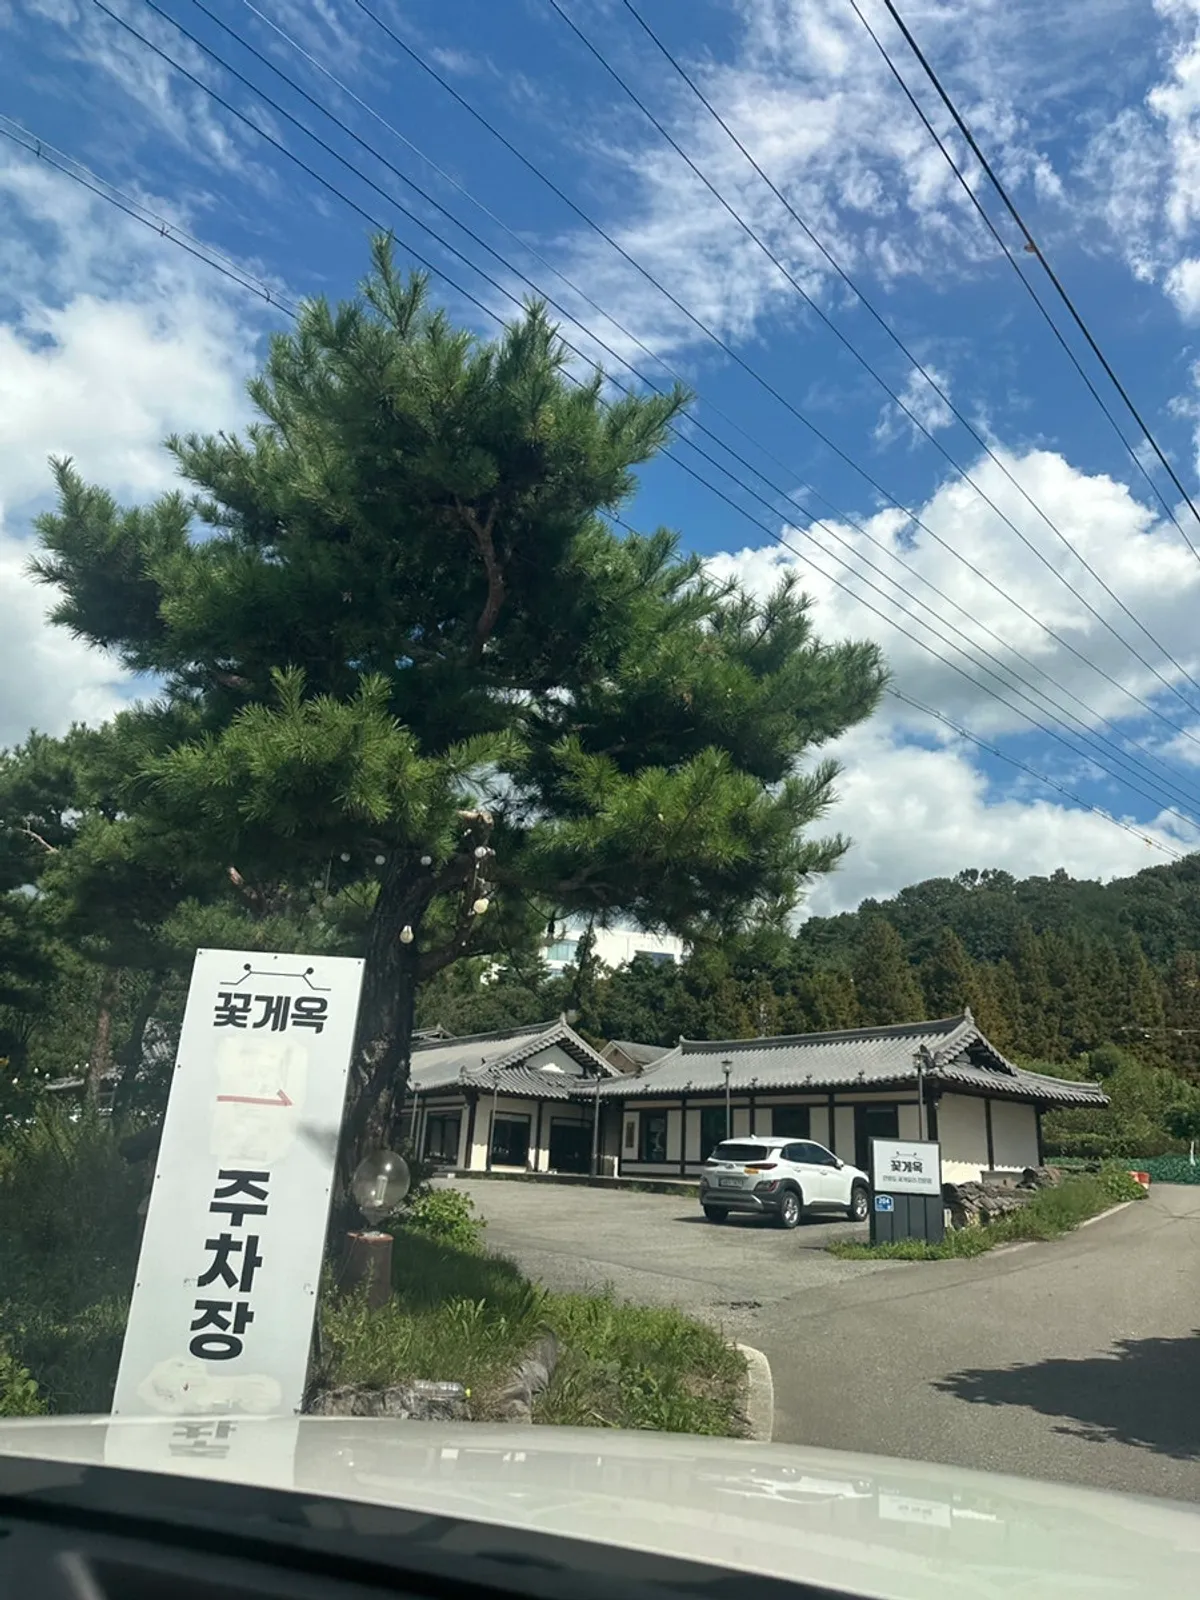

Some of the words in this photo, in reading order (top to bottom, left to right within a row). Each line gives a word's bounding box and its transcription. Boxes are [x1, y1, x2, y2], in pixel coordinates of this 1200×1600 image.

[213, 992, 328, 1034] 꽃게옥
[890, 1160, 923, 1173] 꽃게옥
[189, 1169, 270, 1361] 주차장
